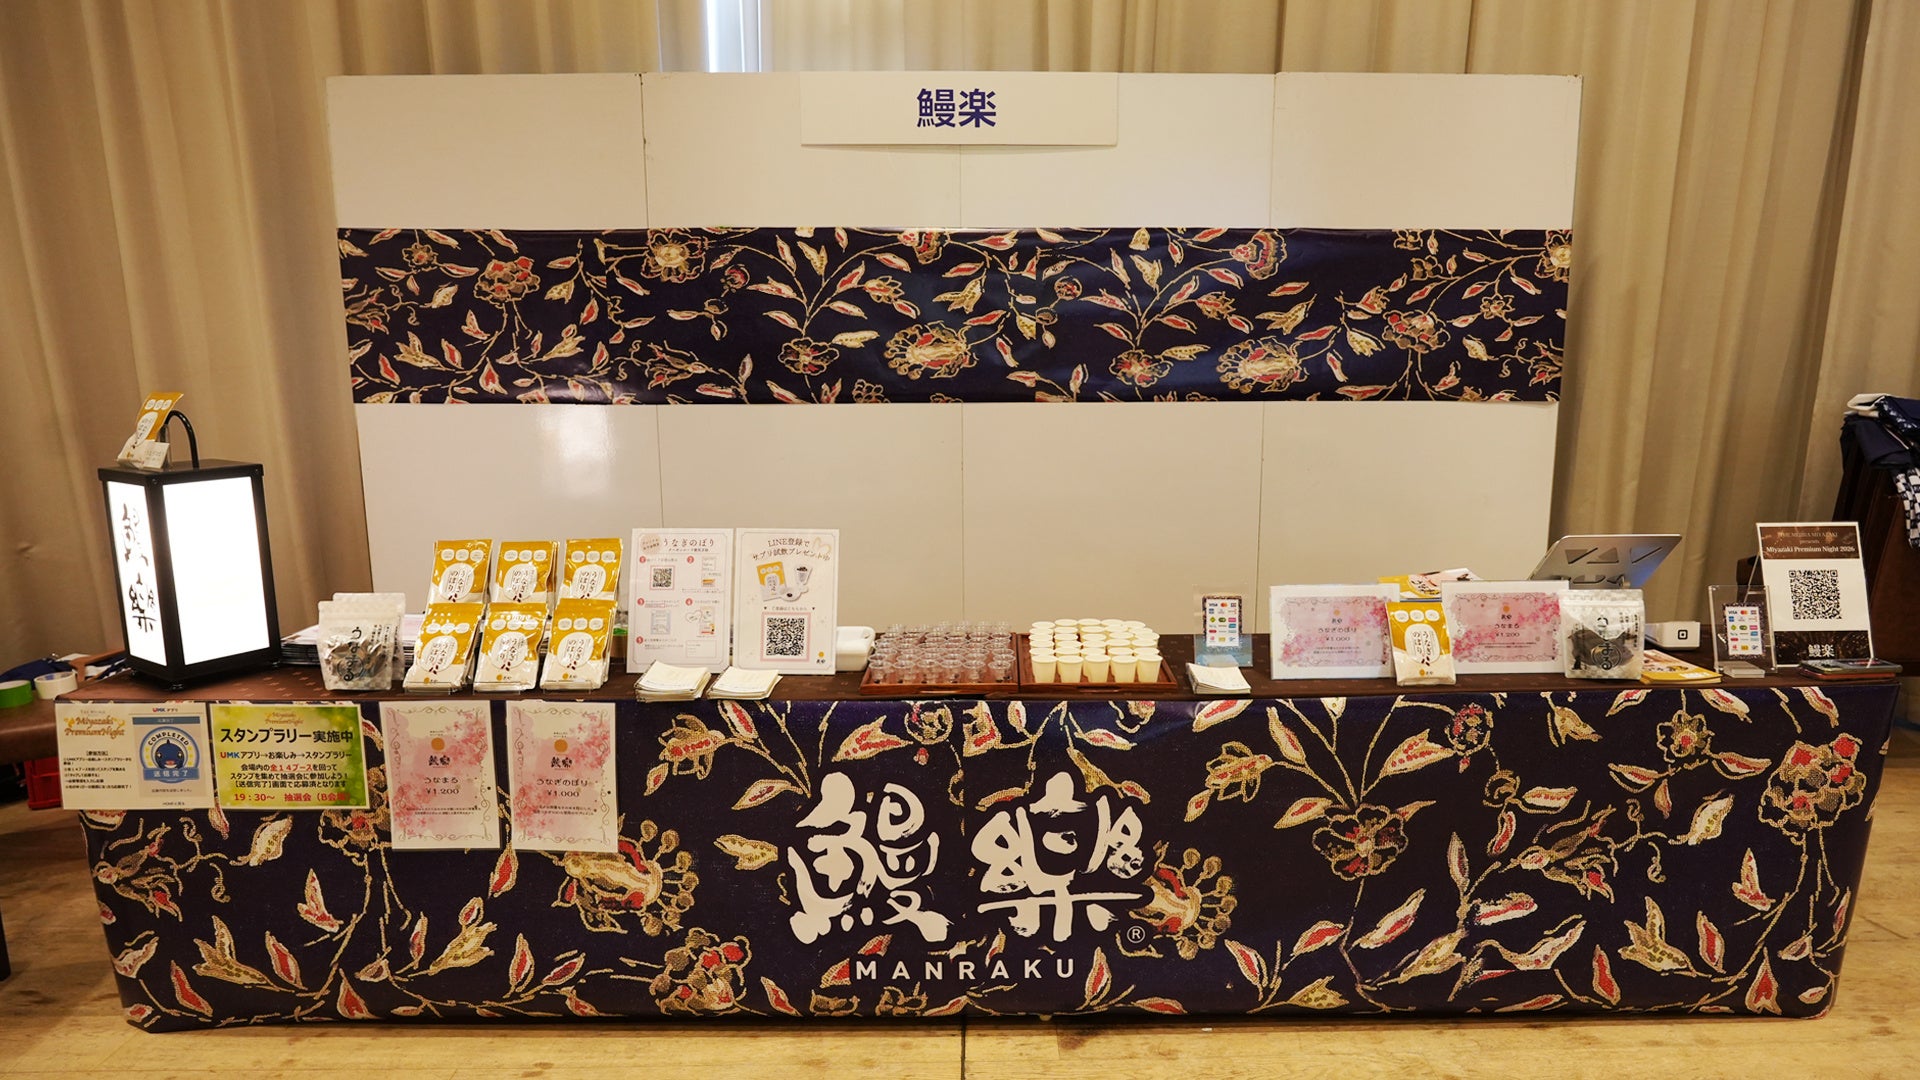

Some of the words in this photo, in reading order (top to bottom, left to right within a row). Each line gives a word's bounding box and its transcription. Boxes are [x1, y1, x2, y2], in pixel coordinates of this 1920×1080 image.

[917, 88, 996, 128] 鰻楽
[663, 538, 714, 548] うなぎのぼり
[768, 538, 810, 548] LINE登録で
[1808, 644, 1834, 658] 鰻楽
[75, 715, 114, 728] Miyazaki
[148, 732, 190, 746] COMPLETED
[220, 728, 353, 743] スタンプラリー実施中
[153, 769, 189, 778] 送信完了
[424, 776, 459, 784] うなまる
[536, 778, 588, 787] うなぎのぼり
[855, 958, 1074, 981] MANRAKU
